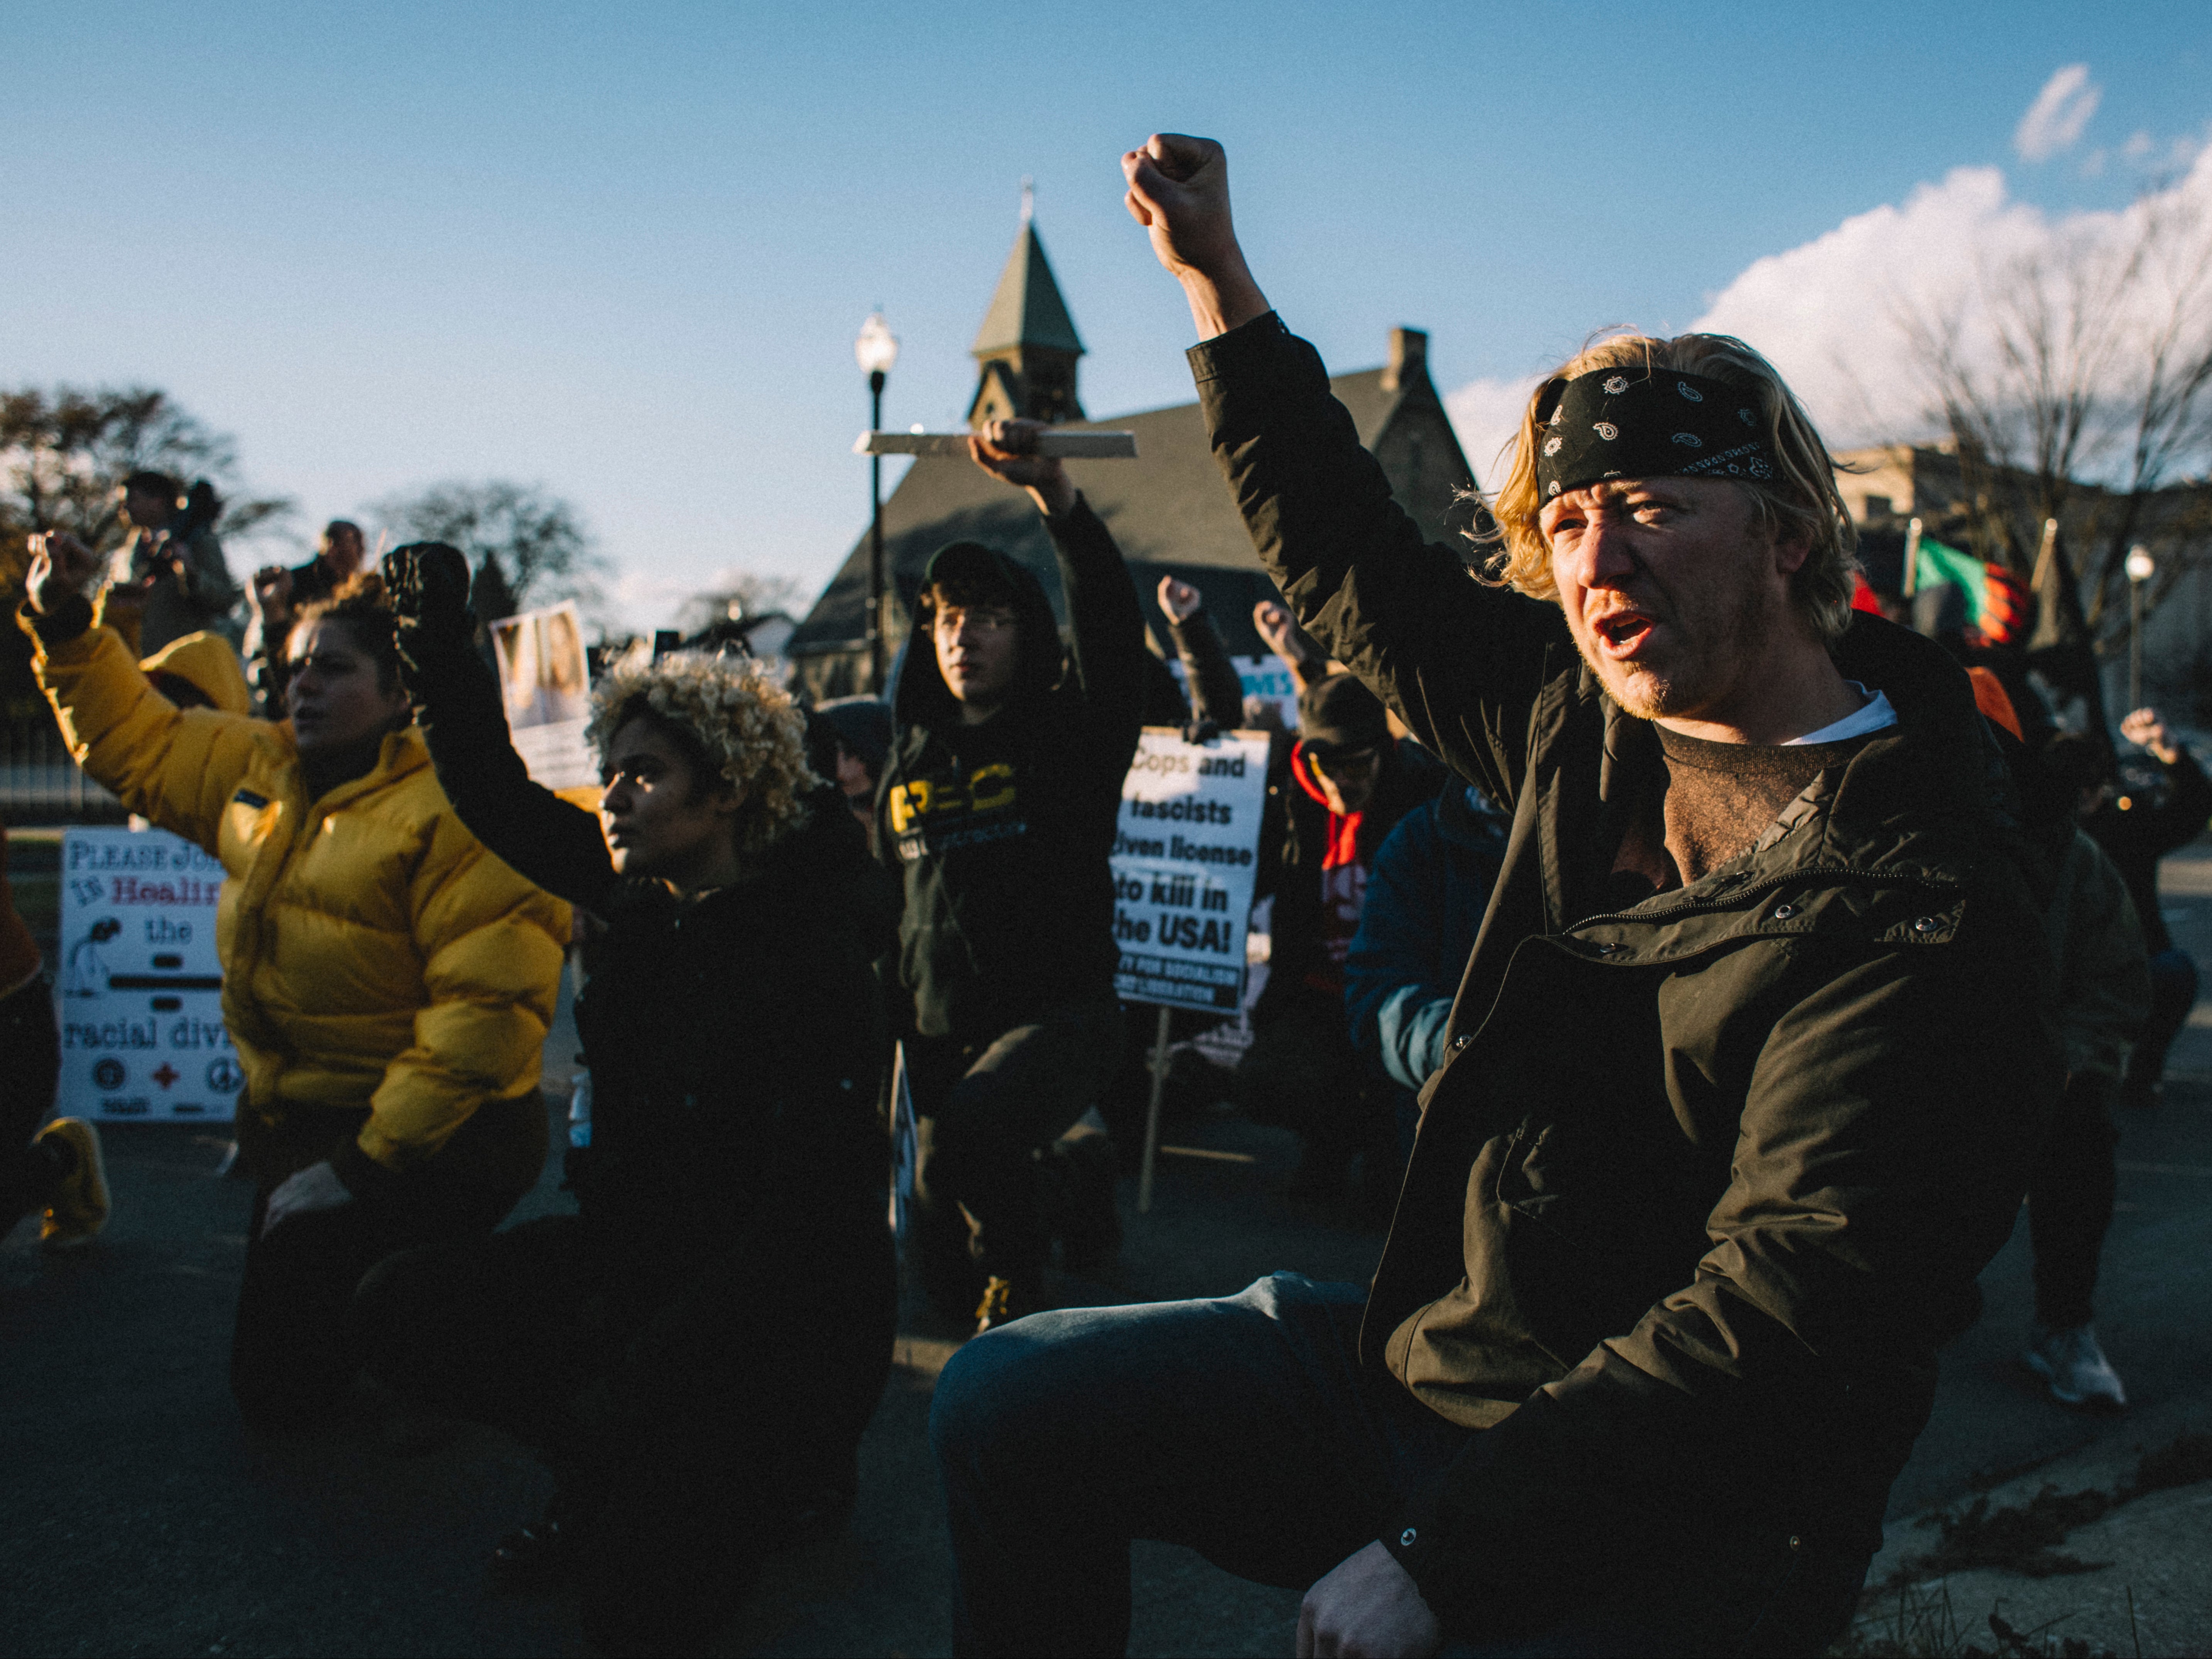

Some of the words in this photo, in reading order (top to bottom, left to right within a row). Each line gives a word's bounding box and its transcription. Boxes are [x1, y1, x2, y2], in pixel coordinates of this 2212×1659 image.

[1198, 752, 1245, 777] and
[1131, 791, 1231, 824] fascists
[69, 840, 167, 870] PLEASE
[1111, 830, 1164, 857] iven
[1170, 834, 1252, 866] license
[1151, 872, 1194, 907] kill
[1201, 879, 1227, 913] in
[145, 917, 192, 945] the
[1116, 909, 1151, 942] he
[1159, 914, 1231, 953] USA!
[64, 1016, 155, 1049] racial
